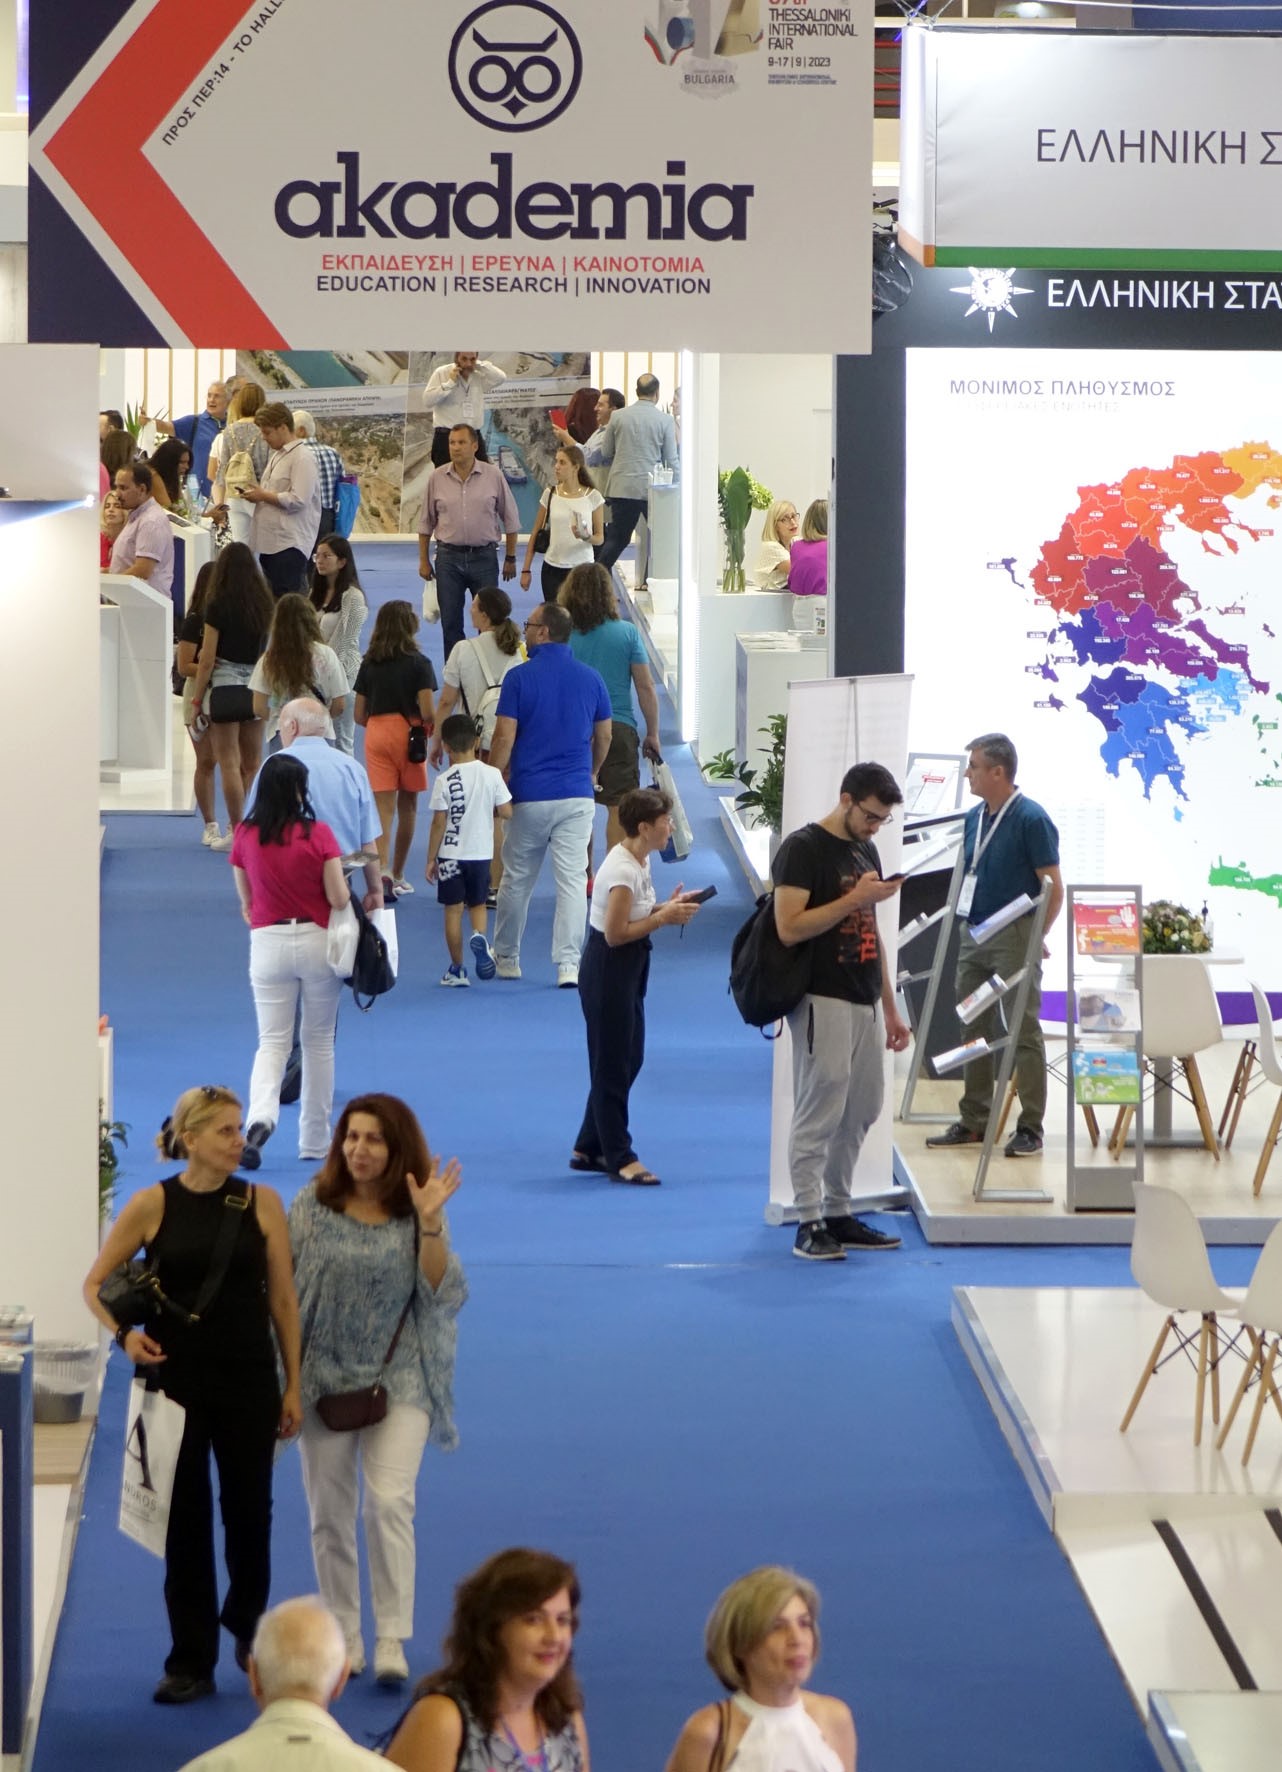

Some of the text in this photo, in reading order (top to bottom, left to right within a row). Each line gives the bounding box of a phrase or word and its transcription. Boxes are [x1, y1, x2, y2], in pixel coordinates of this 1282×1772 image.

[768, 8, 851, 22] THESSALONIKI
[768, 23, 858, 37] INTERNATIONAL
[768, 37, 794, 50] FAIR
[768, 56, 789, 67] 9-17
[808, 57, 831, 67] 2023
[684, 74, 735, 84] BULGARIA
[162, 107, 196, 146] ΠΡΟΣ
[233, 34, 252, 53] TO
[1037, 129, 1246, 165] ΕΛΛΗΝΙΚΗ
[274, 151, 754, 241] akademia
[321, 254, 454, 271] ΕΚΠΑΙΔΕΥΣΗ
[472, 255, 555, 272] ΕΡΕΥΝΑ
[574, 256, 705, 274] ΚΑΙΝΟΤΟΜΙΑ
[317, 275, 436, 292] EDUCATION
[454, 275, 568, 293] RESEARCH
[587, 277, 711, 294] INNOVATION
[1048, 279, 1282, 309] ΕΛΛΗΝΙΚΗ ΣΤΑ
[949, 379, 1176, 397] ΜΟΝΙΜΟΣ ΠΛΗΘΥΣΜΟΣ
[445, 769, 466, 847] FLORIDA
